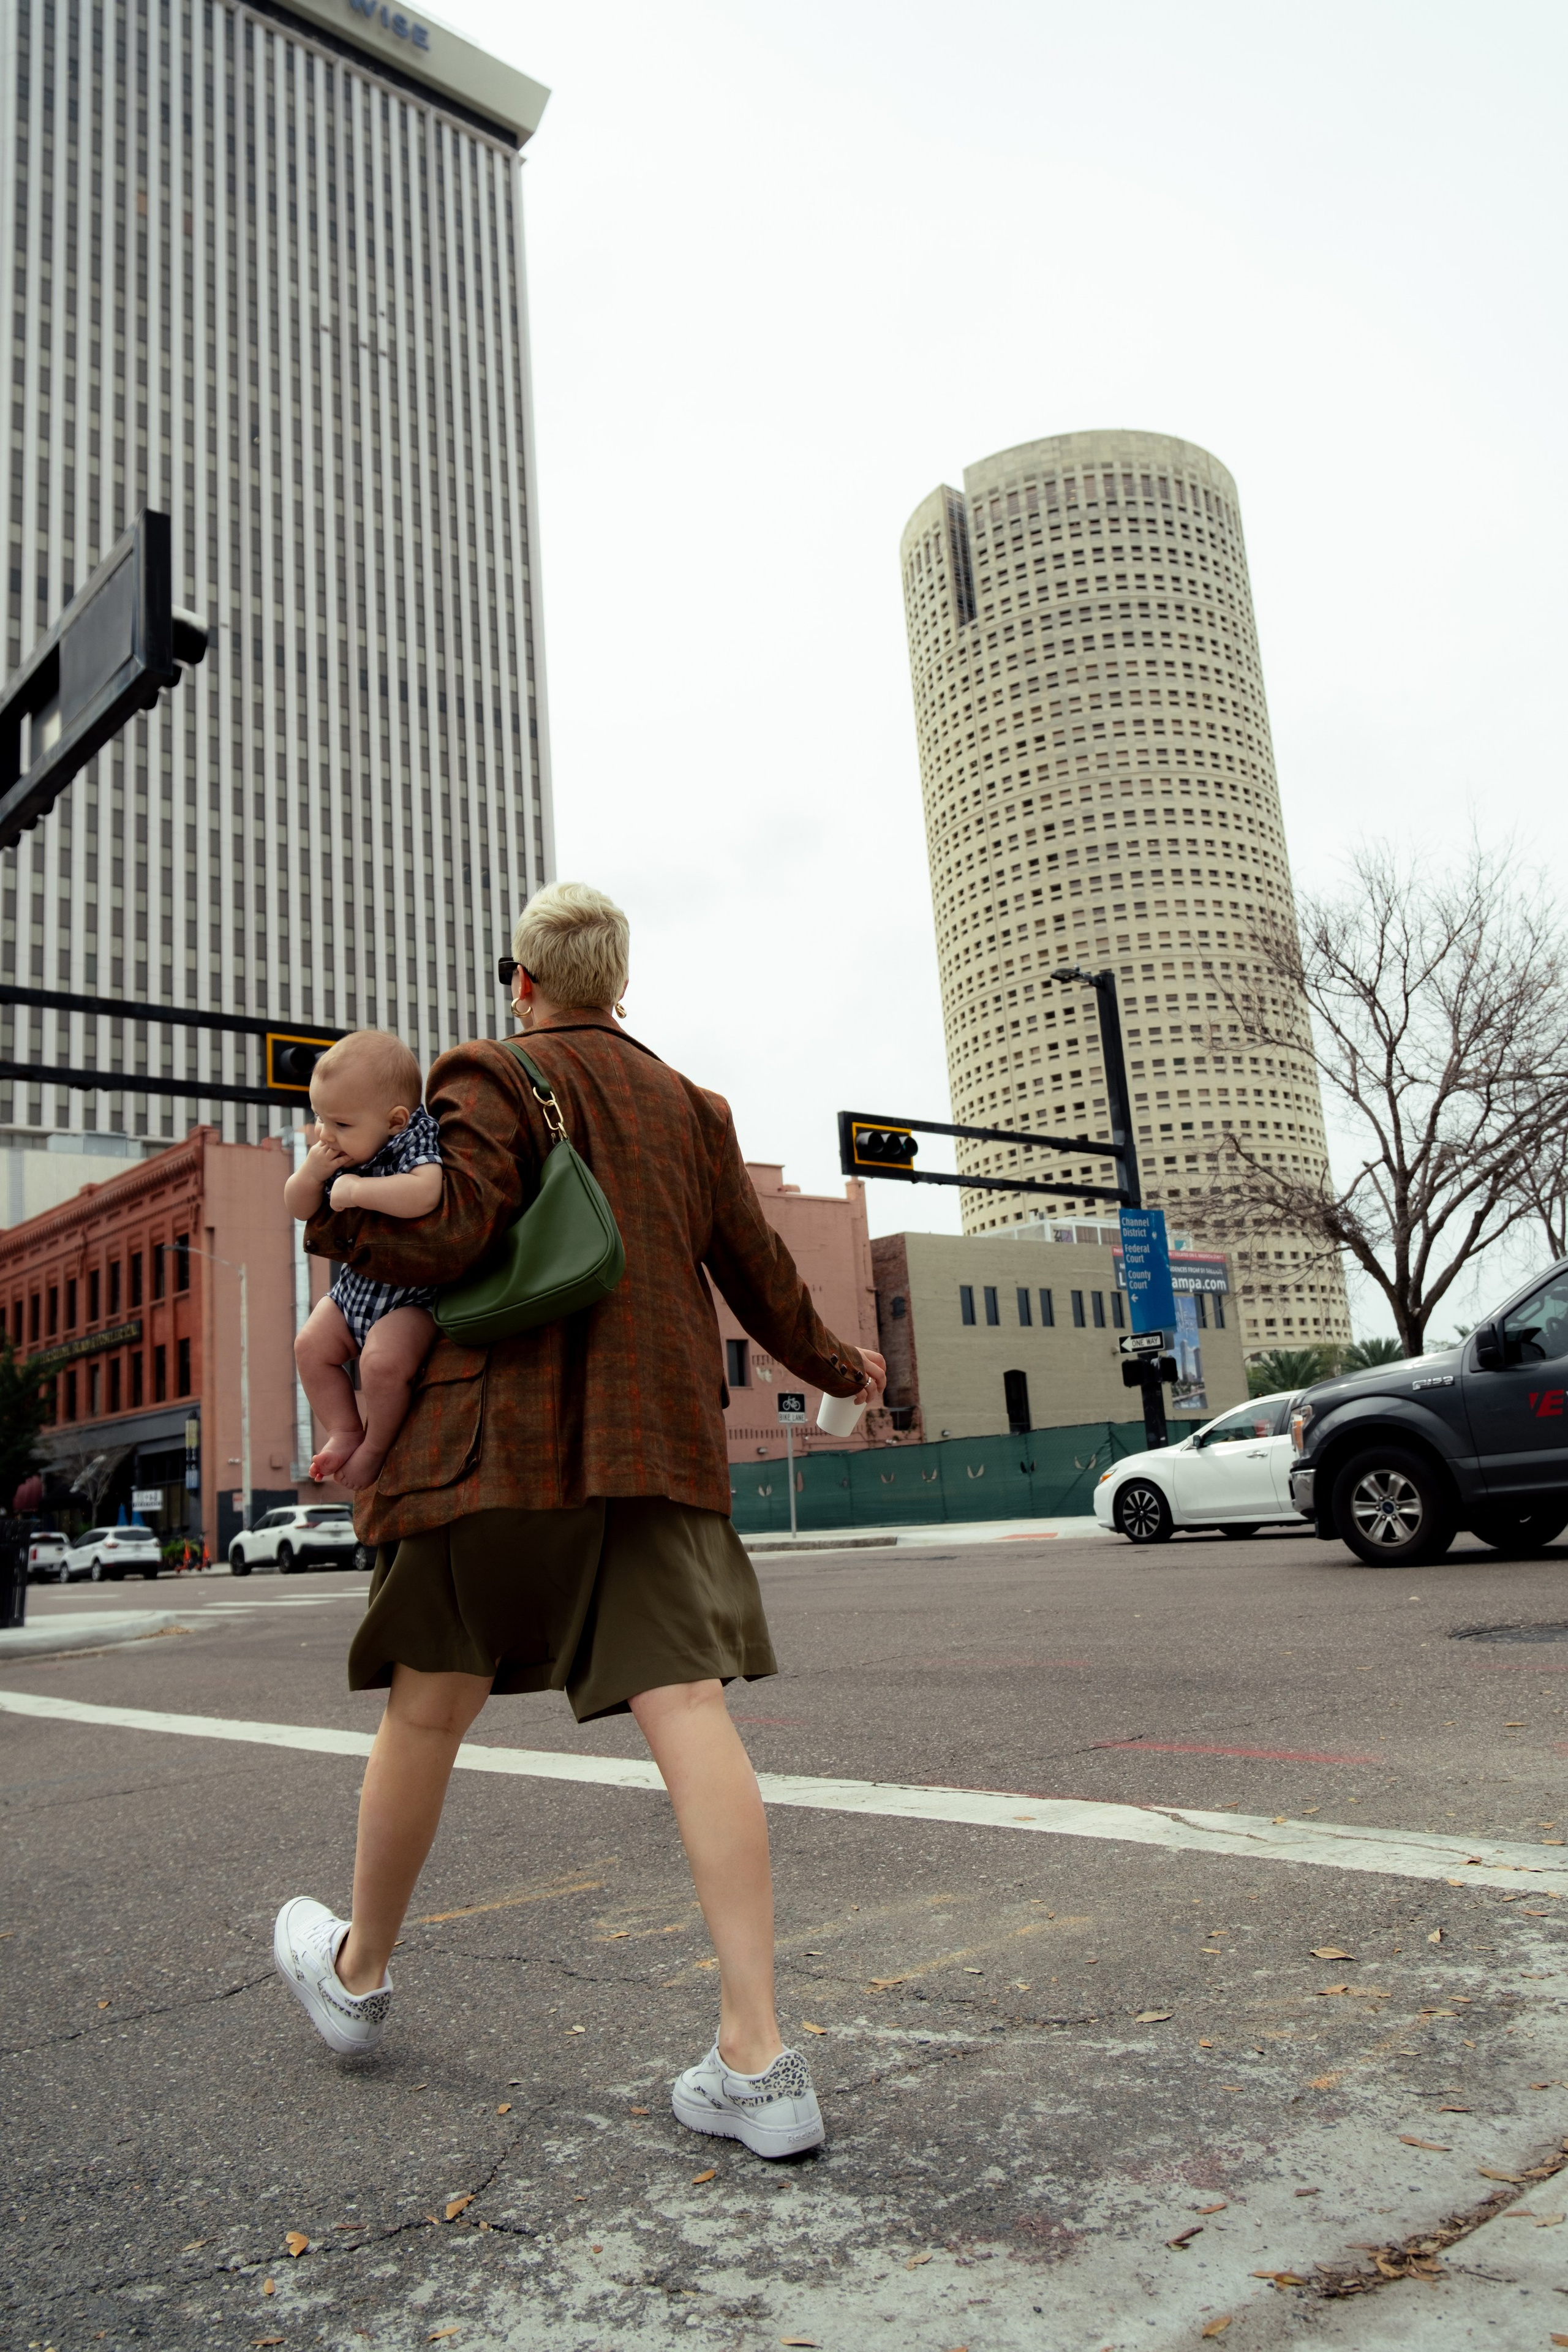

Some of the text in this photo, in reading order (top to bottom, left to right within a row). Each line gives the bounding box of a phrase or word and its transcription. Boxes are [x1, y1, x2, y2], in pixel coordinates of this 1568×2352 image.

[1121, 1217, 1150, 1227] Channel
[1123, 1227, 1147, 1237] District
[1125, 1243, 1150, 1253] Federal
[1126, 1254, 1145, 1263] Court
[1128, 1270, 1151, 1281] County
[1129, 1280, 1148, 1289] Court
[1132, 1336, 1158, 1347] ONE WAY
